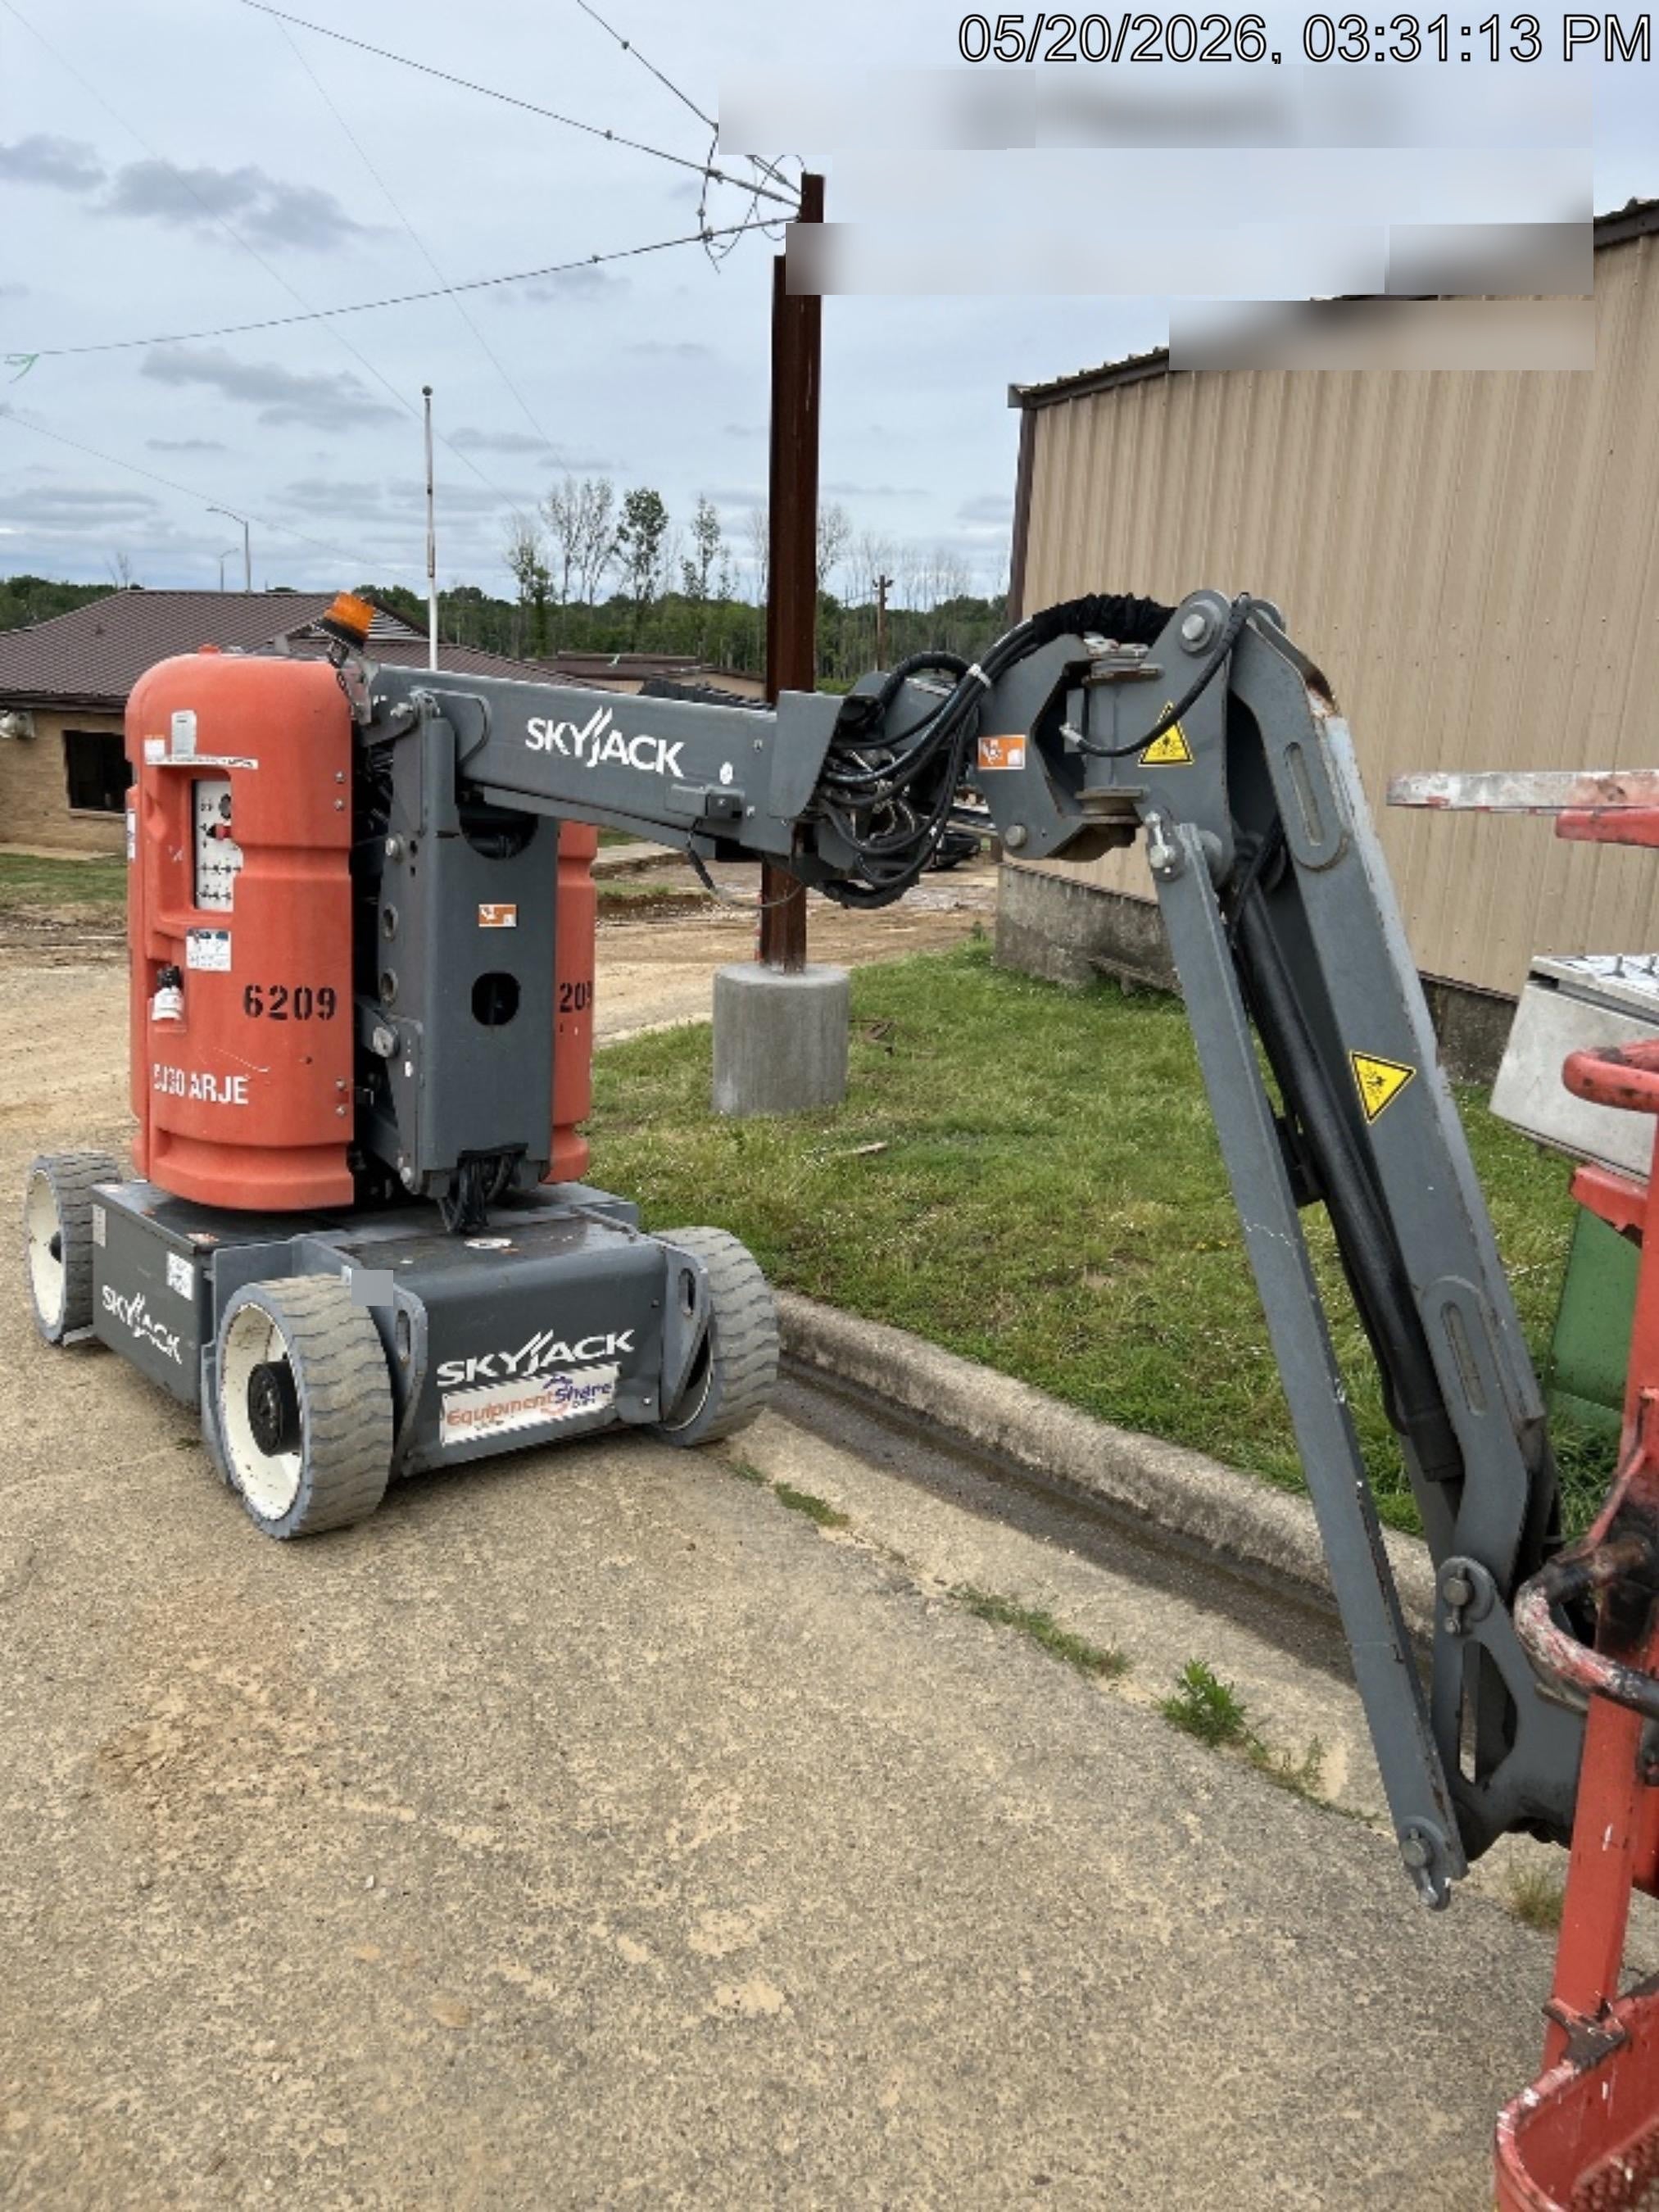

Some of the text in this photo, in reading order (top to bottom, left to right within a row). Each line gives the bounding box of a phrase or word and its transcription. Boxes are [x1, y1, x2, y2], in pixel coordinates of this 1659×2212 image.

[525, 706, 685, 778] SKYJACK
[244, 985, 336, 1021] 6209
[188, 1071, 249, 1104] ARJE
[437, 1329, 635, 1387] SKYJACK
